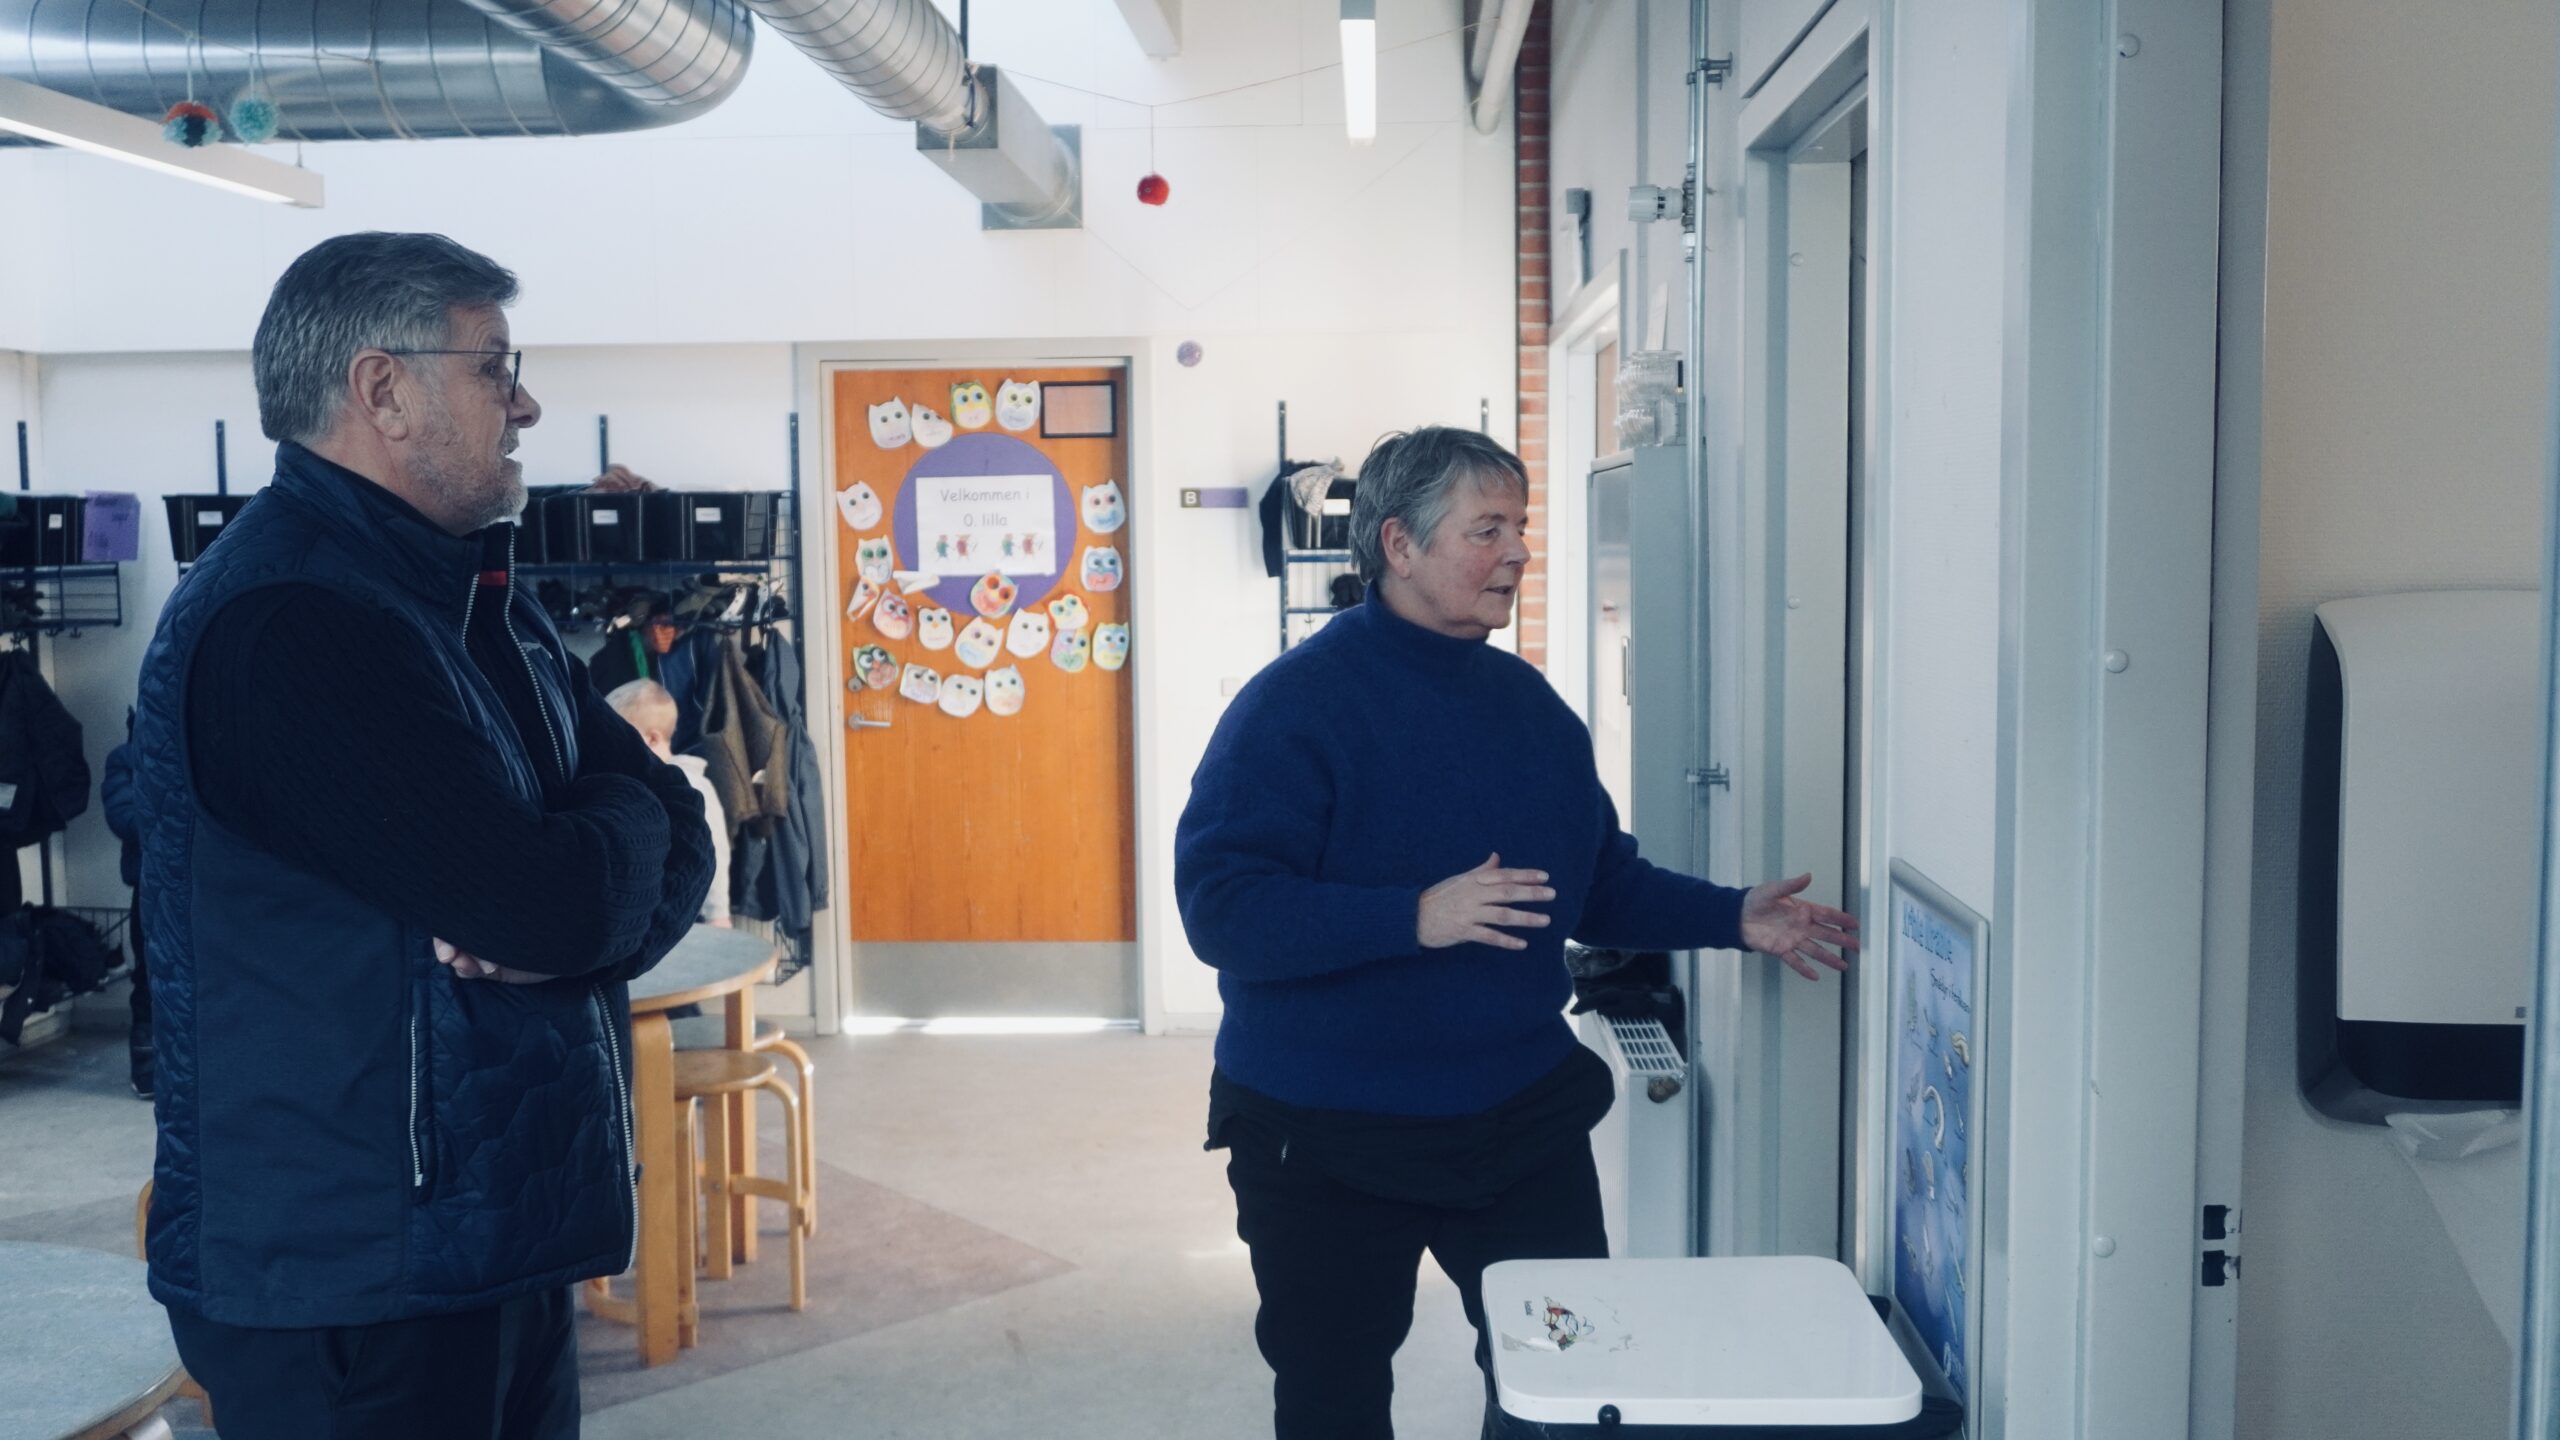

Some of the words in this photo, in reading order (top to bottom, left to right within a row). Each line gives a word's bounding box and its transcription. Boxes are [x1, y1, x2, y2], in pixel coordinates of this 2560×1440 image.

[940, 487, 1021, 502] Velkommen
[1185, 491, 1197, 504] B
[982, 512, 1008, 527] lilla
